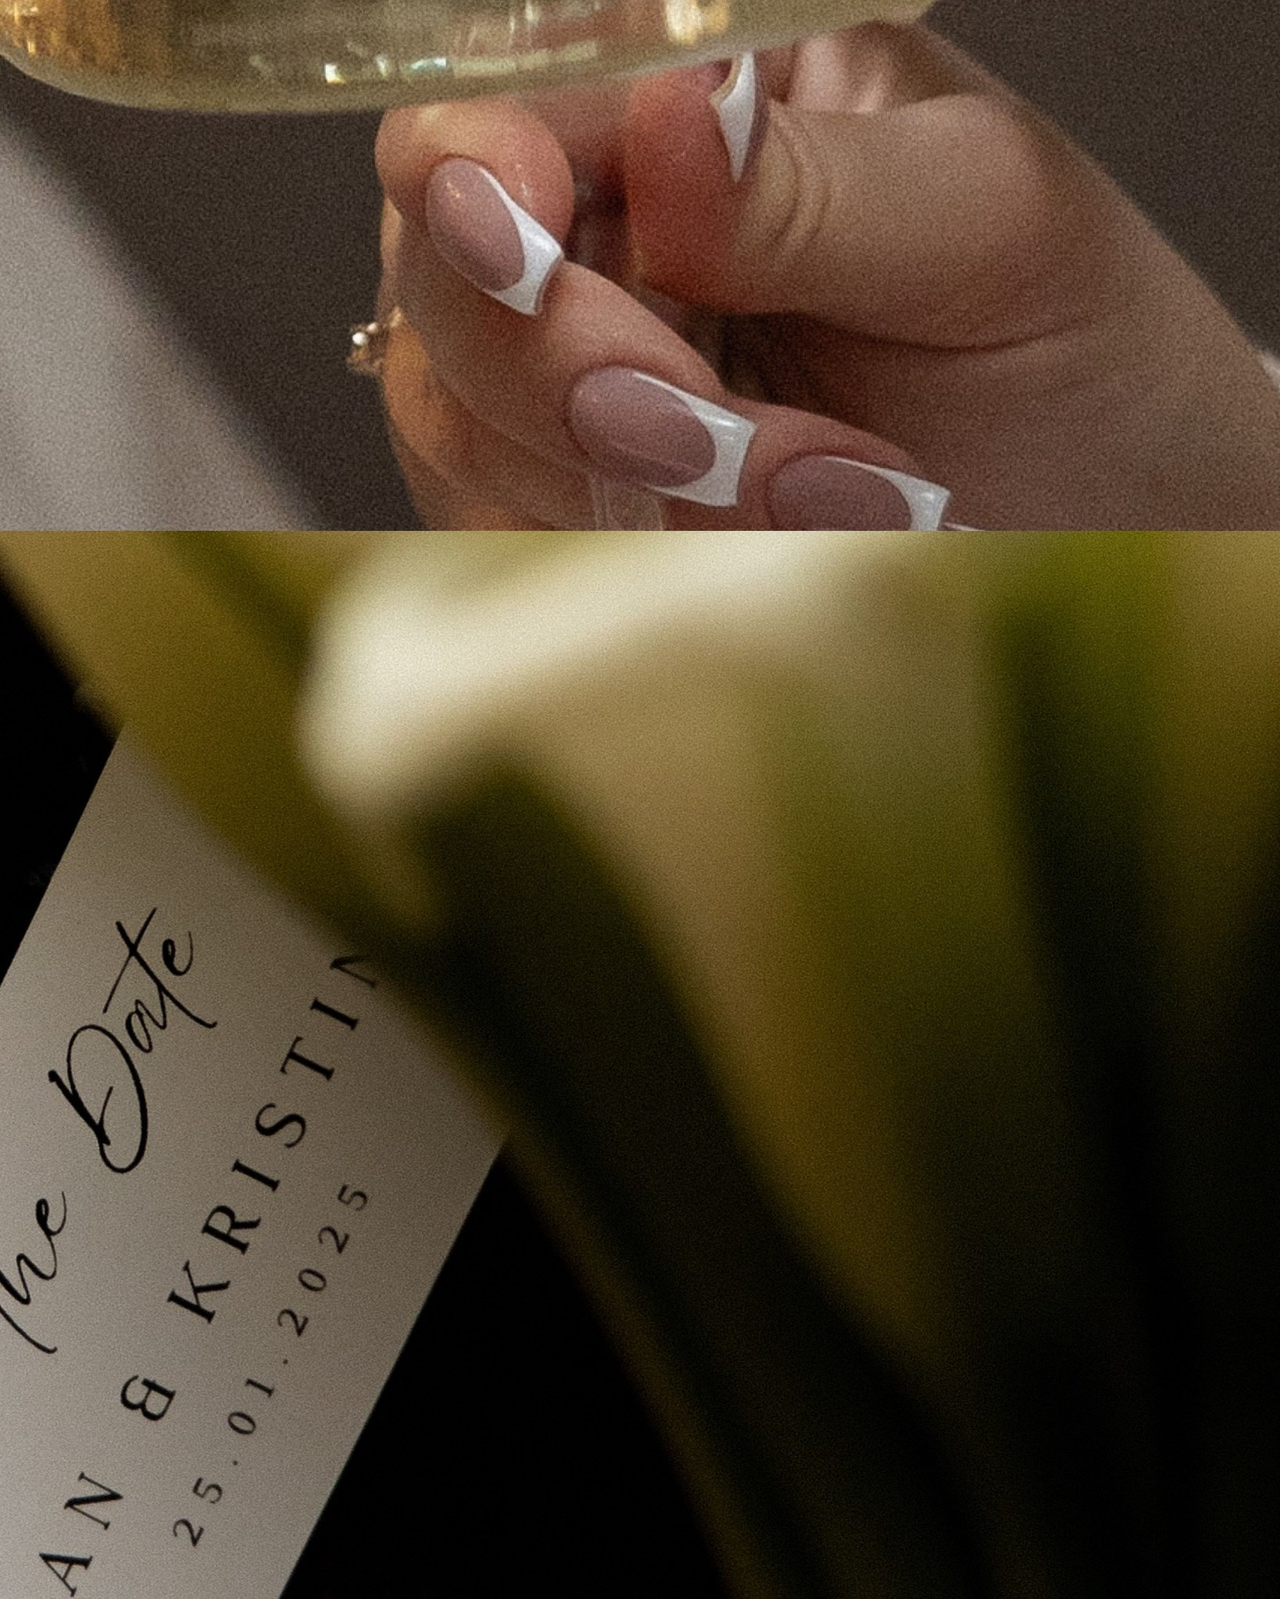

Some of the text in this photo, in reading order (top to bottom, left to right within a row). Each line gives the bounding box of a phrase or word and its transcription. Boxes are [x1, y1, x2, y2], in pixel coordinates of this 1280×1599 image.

[47, 907, 218, 1174] Date
[120, 1374, 176, 1422] &
[173, 1183, 370, 1548] 25.01.2025
